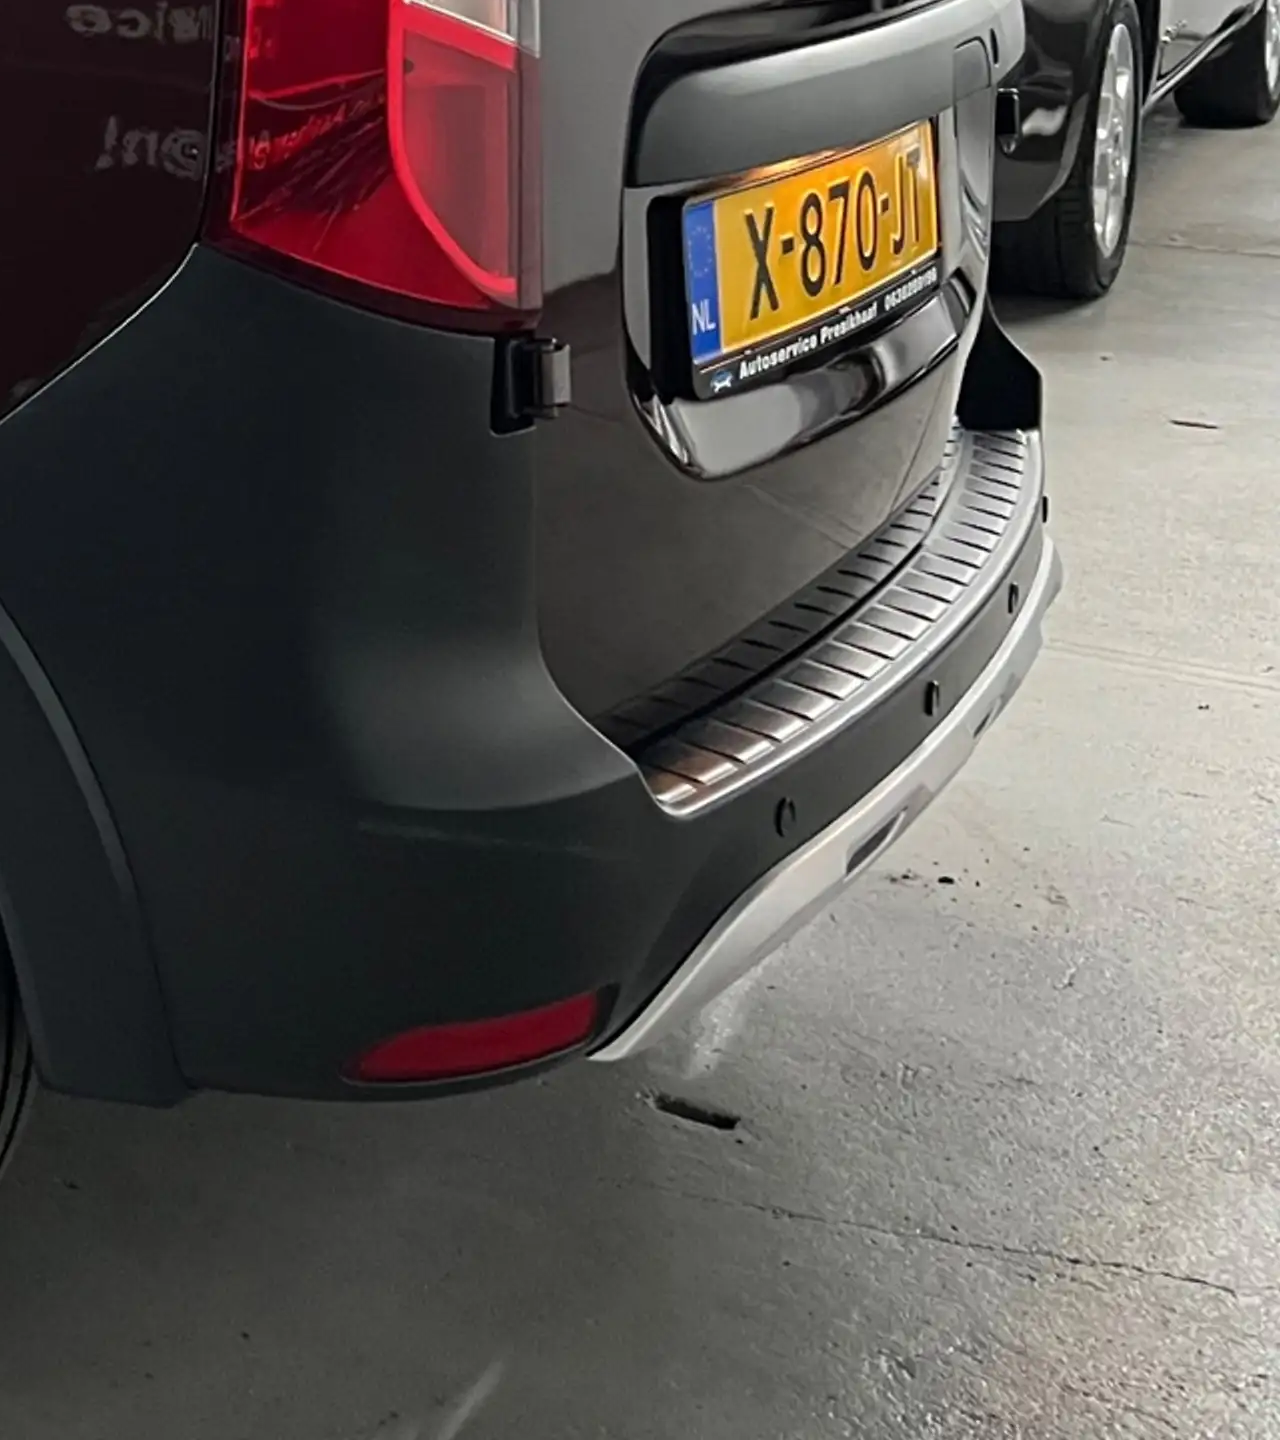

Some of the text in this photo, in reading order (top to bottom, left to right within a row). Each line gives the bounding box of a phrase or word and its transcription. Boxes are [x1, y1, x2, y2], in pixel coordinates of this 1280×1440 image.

[743, 143, 922, 322] X-870-JT
[692, 299, 716, 336] NL
[739, 333, 818, 381] Autoservice
